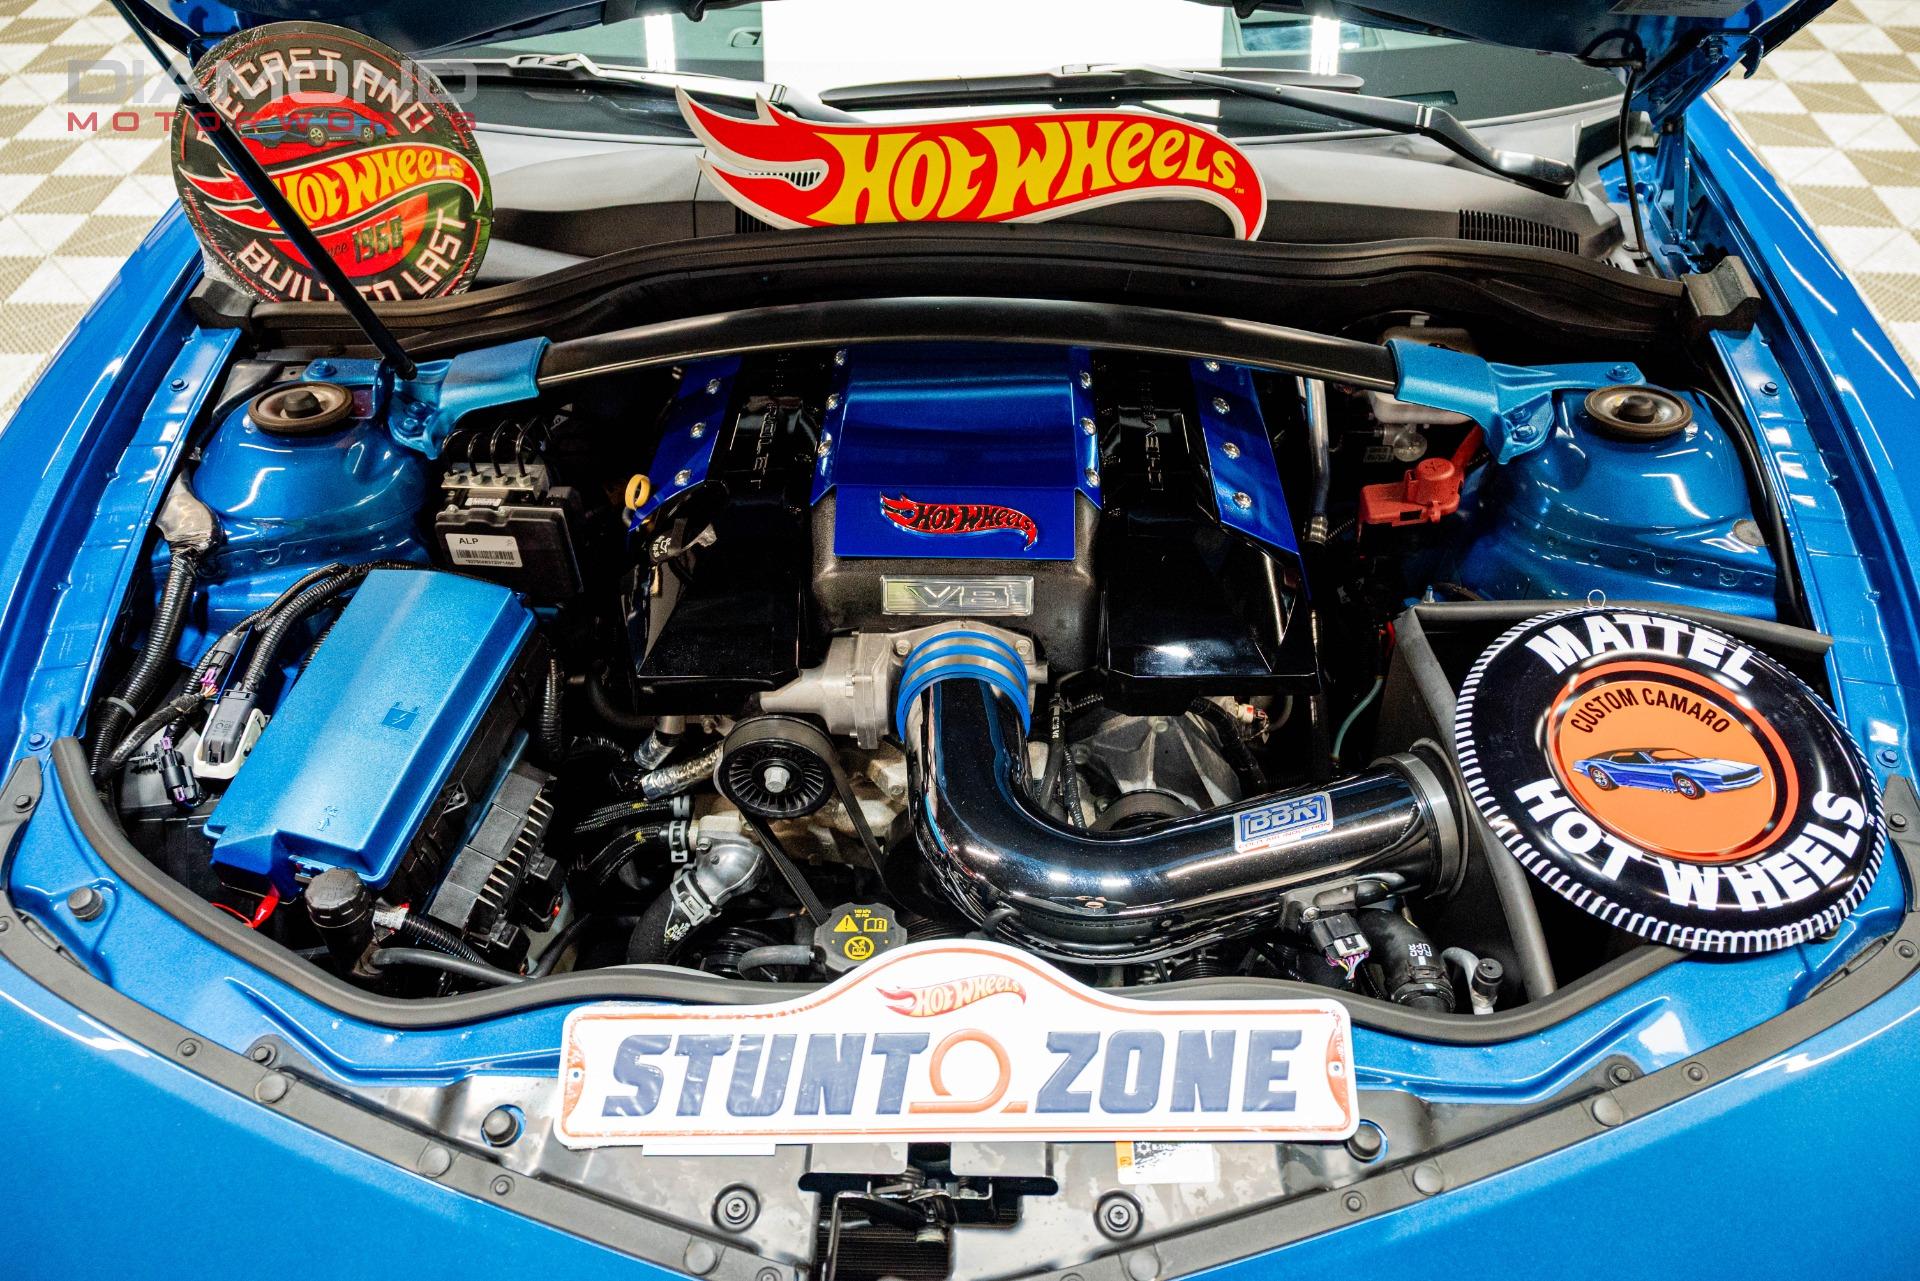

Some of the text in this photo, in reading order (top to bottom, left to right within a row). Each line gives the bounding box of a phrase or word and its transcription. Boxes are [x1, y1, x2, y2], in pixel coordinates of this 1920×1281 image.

[352, 61, 434, 134] AND
[401, 207, 466, 295] LAST
[459, 537, 479, 545] ALP
[1525, 614, 1757, 685] MATTEL
[1570, 687, 1731, 734] CUSTOM CAMARO
[1516, 777, 1645, 882] HOT
[1657, 789, 1866, 912] WHEELS
[602, 1030, 1303, 1118] STUNT ZONE
